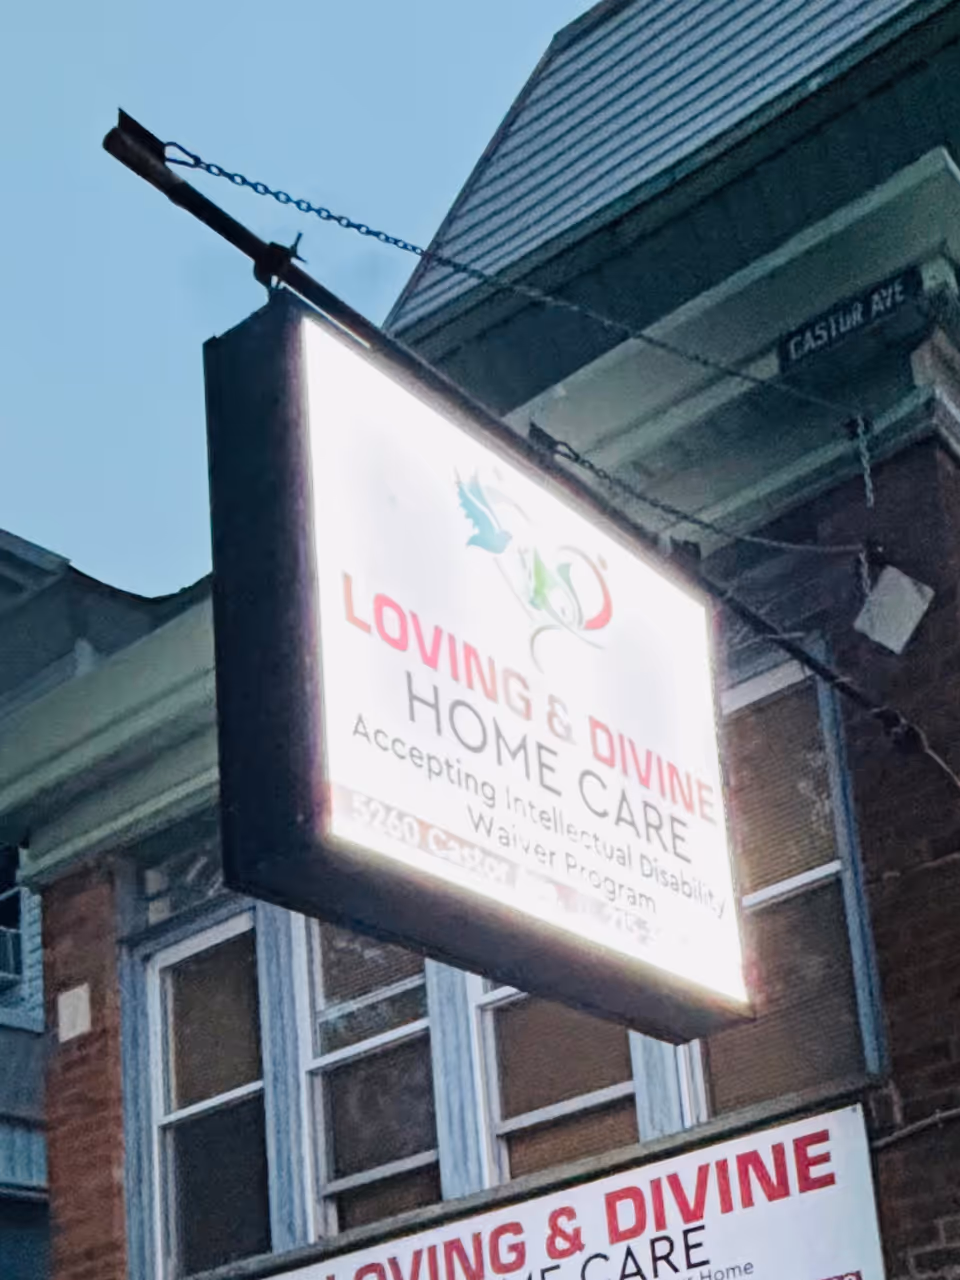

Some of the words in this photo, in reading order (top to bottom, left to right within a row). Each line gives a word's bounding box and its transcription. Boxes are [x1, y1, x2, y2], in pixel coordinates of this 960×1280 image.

[789, 302, 864, 360] CASTOR
[871, 278, 904, 317] AVE
[342, 570, 533, 722] LOVING
[547, 692, 577, 745] &
[588, 714, 718, 826] DIVINE
[350, 793, 420, 845] 5260
[352, 712, 497, 810] Accepting
[505, 787, 633, 870] Intellectual
[639, 852, 728, 920] Disability
[404, 669, 563, 798] HOME
[577, 768, 693, 865] CARE
[466, 803, 557, 868] Waiver
[564, 850, 657, 916] Program
[545, 1204, 585, 1259] &
[603, 1128, 836, 1243] DIVINE
